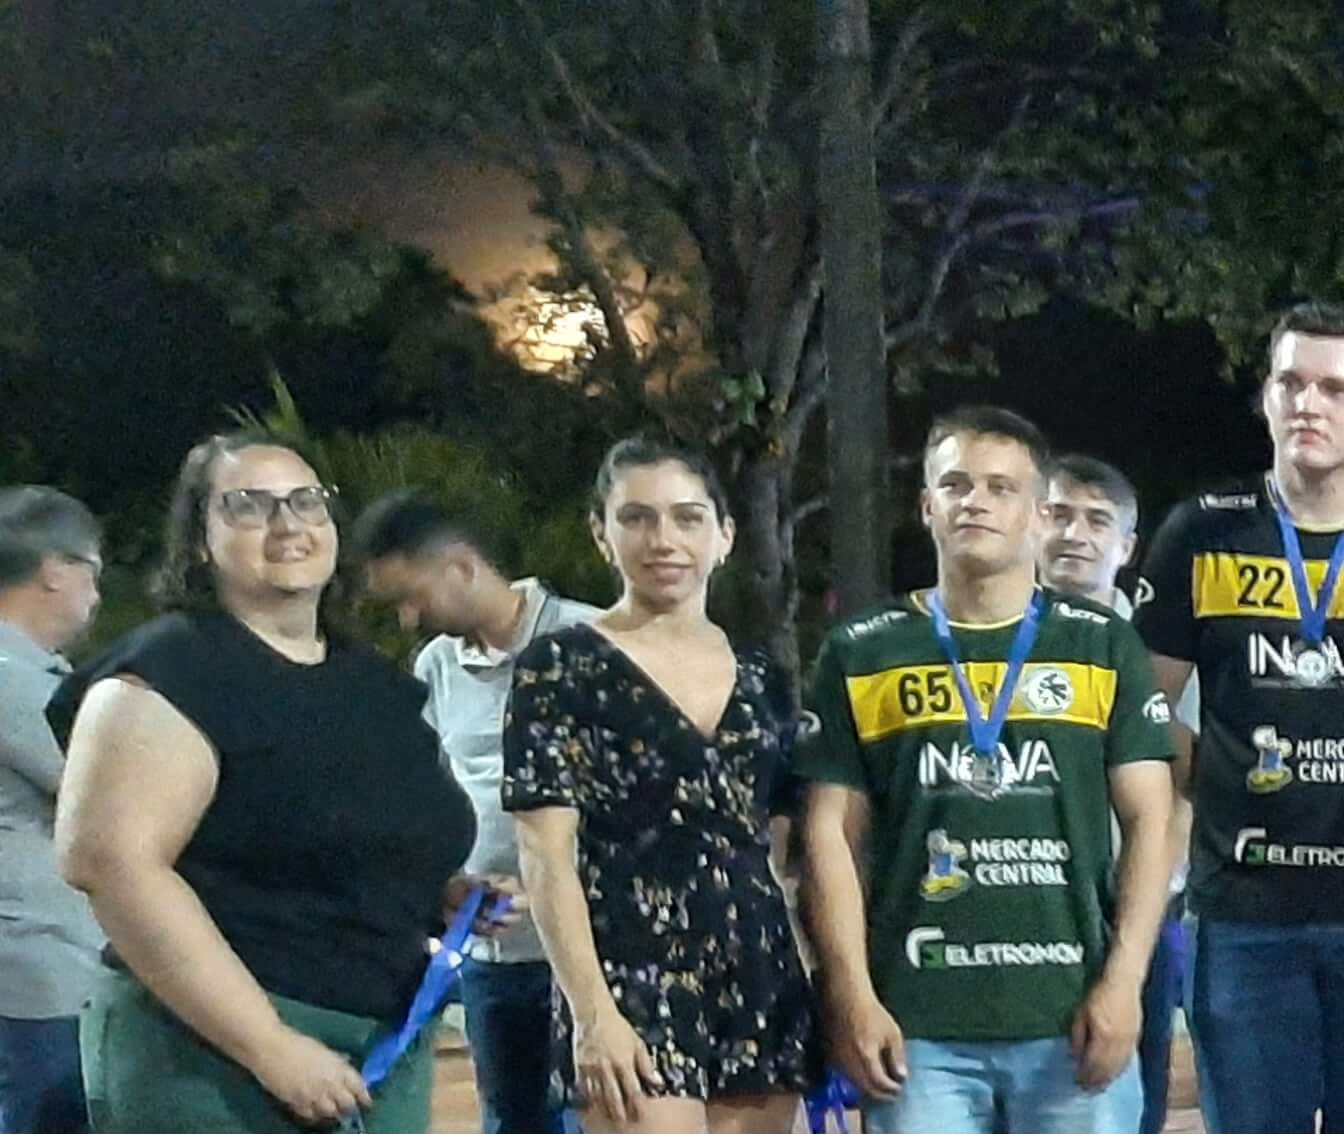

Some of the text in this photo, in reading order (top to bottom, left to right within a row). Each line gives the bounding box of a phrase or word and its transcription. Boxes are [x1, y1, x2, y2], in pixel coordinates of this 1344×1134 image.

[1239, 564, 1286, 609] 22
[899, 670, 953, 717] 65
[918, 740, 1061, 785] INVA
[970, 838, 1071, 861] MERCADO
[975, 862, 1069, 885] CENTRAL
